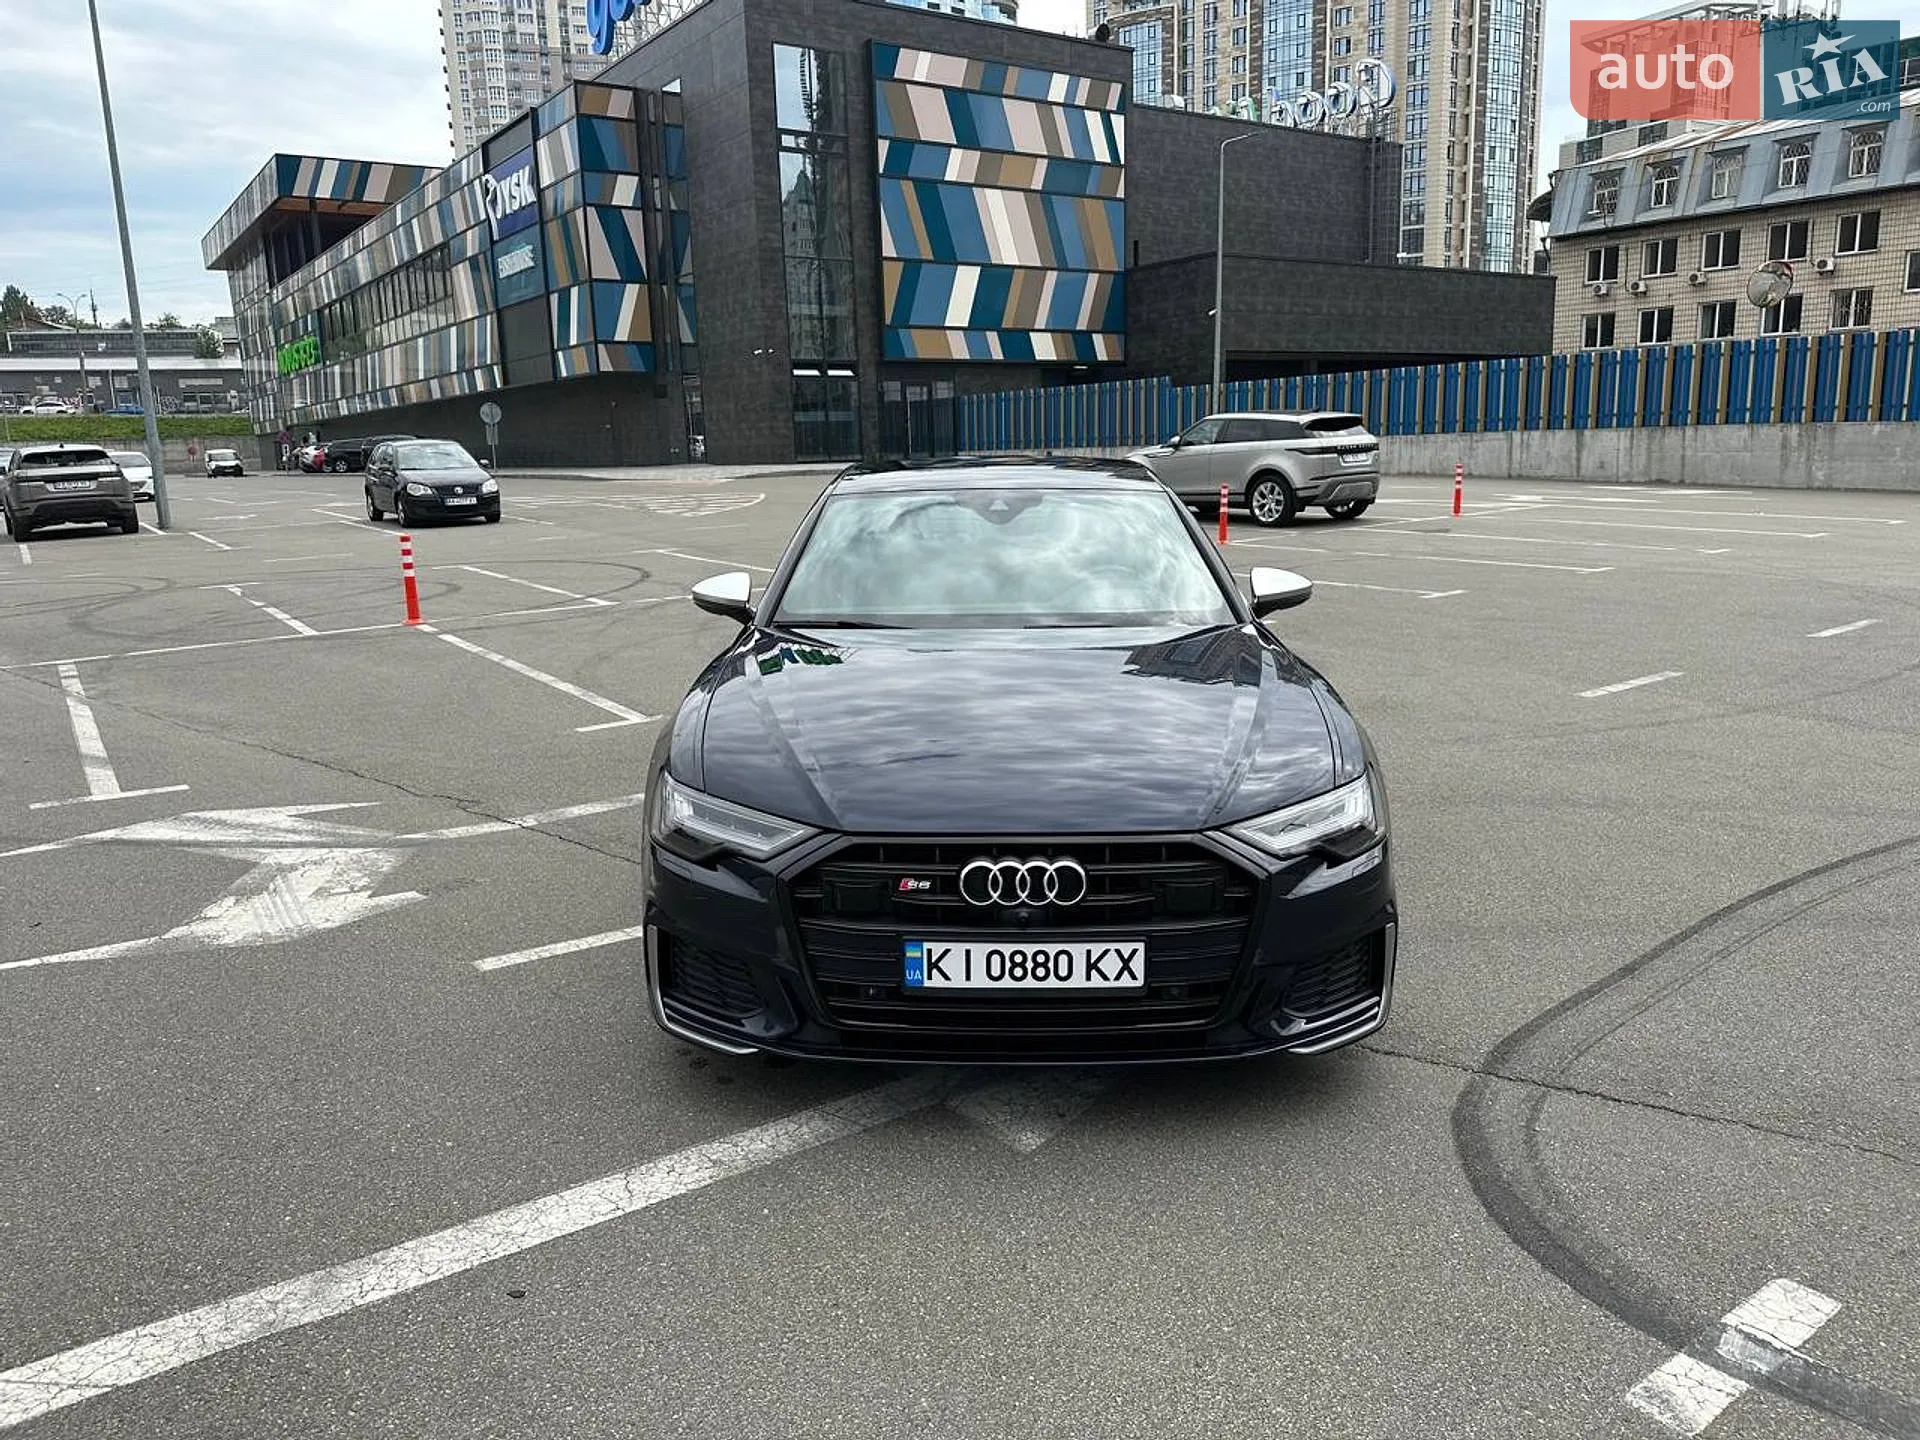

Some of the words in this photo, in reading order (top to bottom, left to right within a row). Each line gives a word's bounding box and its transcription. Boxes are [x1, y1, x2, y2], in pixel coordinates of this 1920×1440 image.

[495, 165, 537, 219] JYSK
[905, 969, 922, 981] UA
[985, 949, 1074, 982] 0880
[1085, 948, 1140, 982] KX
